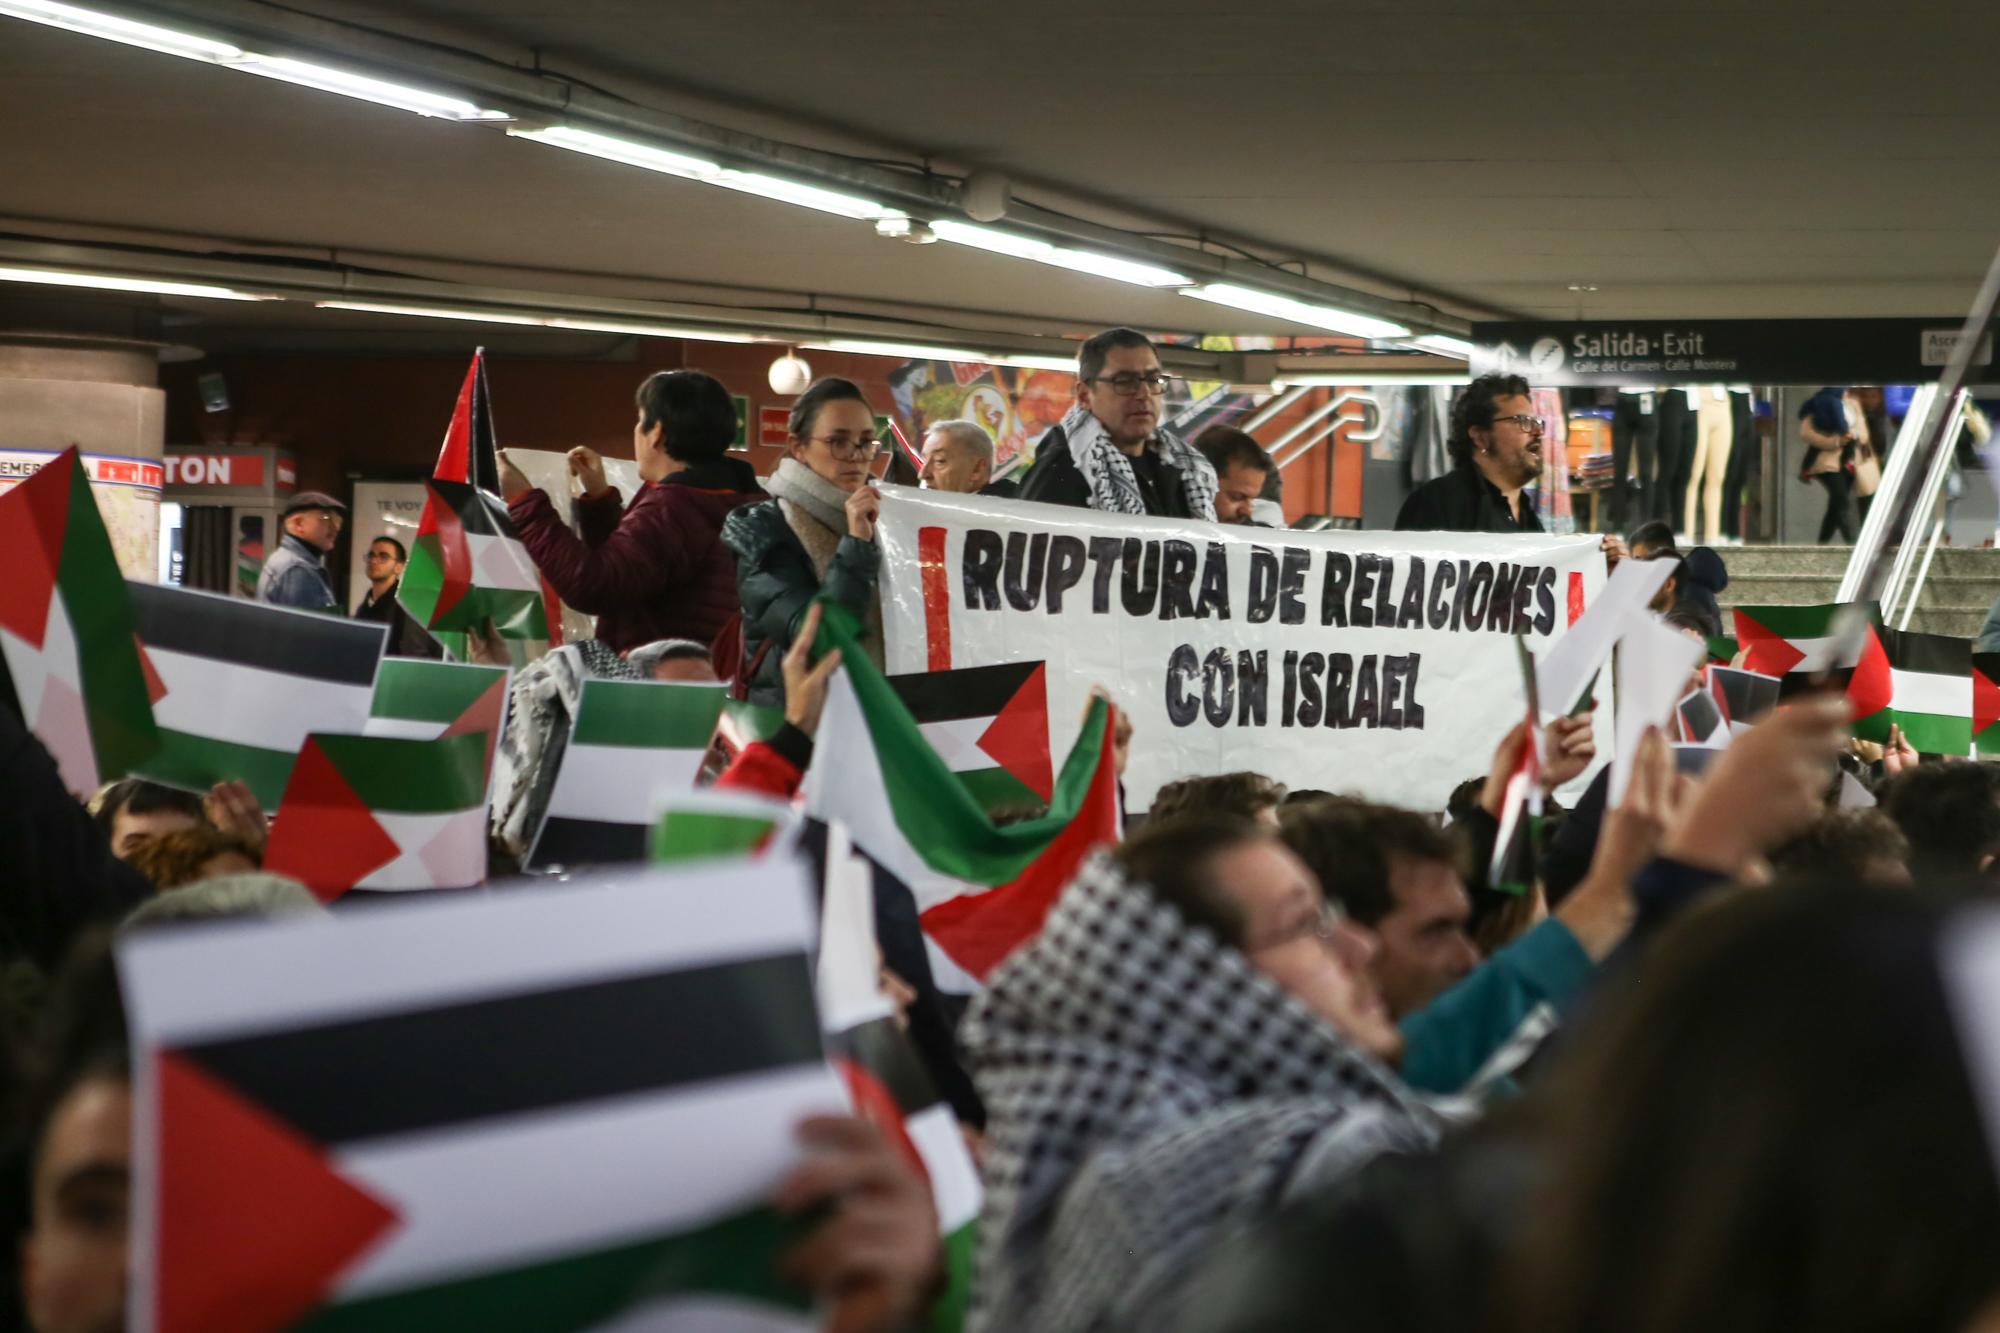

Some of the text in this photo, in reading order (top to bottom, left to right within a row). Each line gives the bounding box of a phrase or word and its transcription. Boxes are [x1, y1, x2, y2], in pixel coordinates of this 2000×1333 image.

[1572, 361, 1599, 373] Calle
[1601, 360, 1617, 372] del
[1694, 358, 1737, 371] Montera
[1573, 332, 1705, 357] Salida Exit
[962, 529, 1556, 636] RUPTURA DE RELACIONES
[1165, 643, 1424, 730] CON ISRAEL
